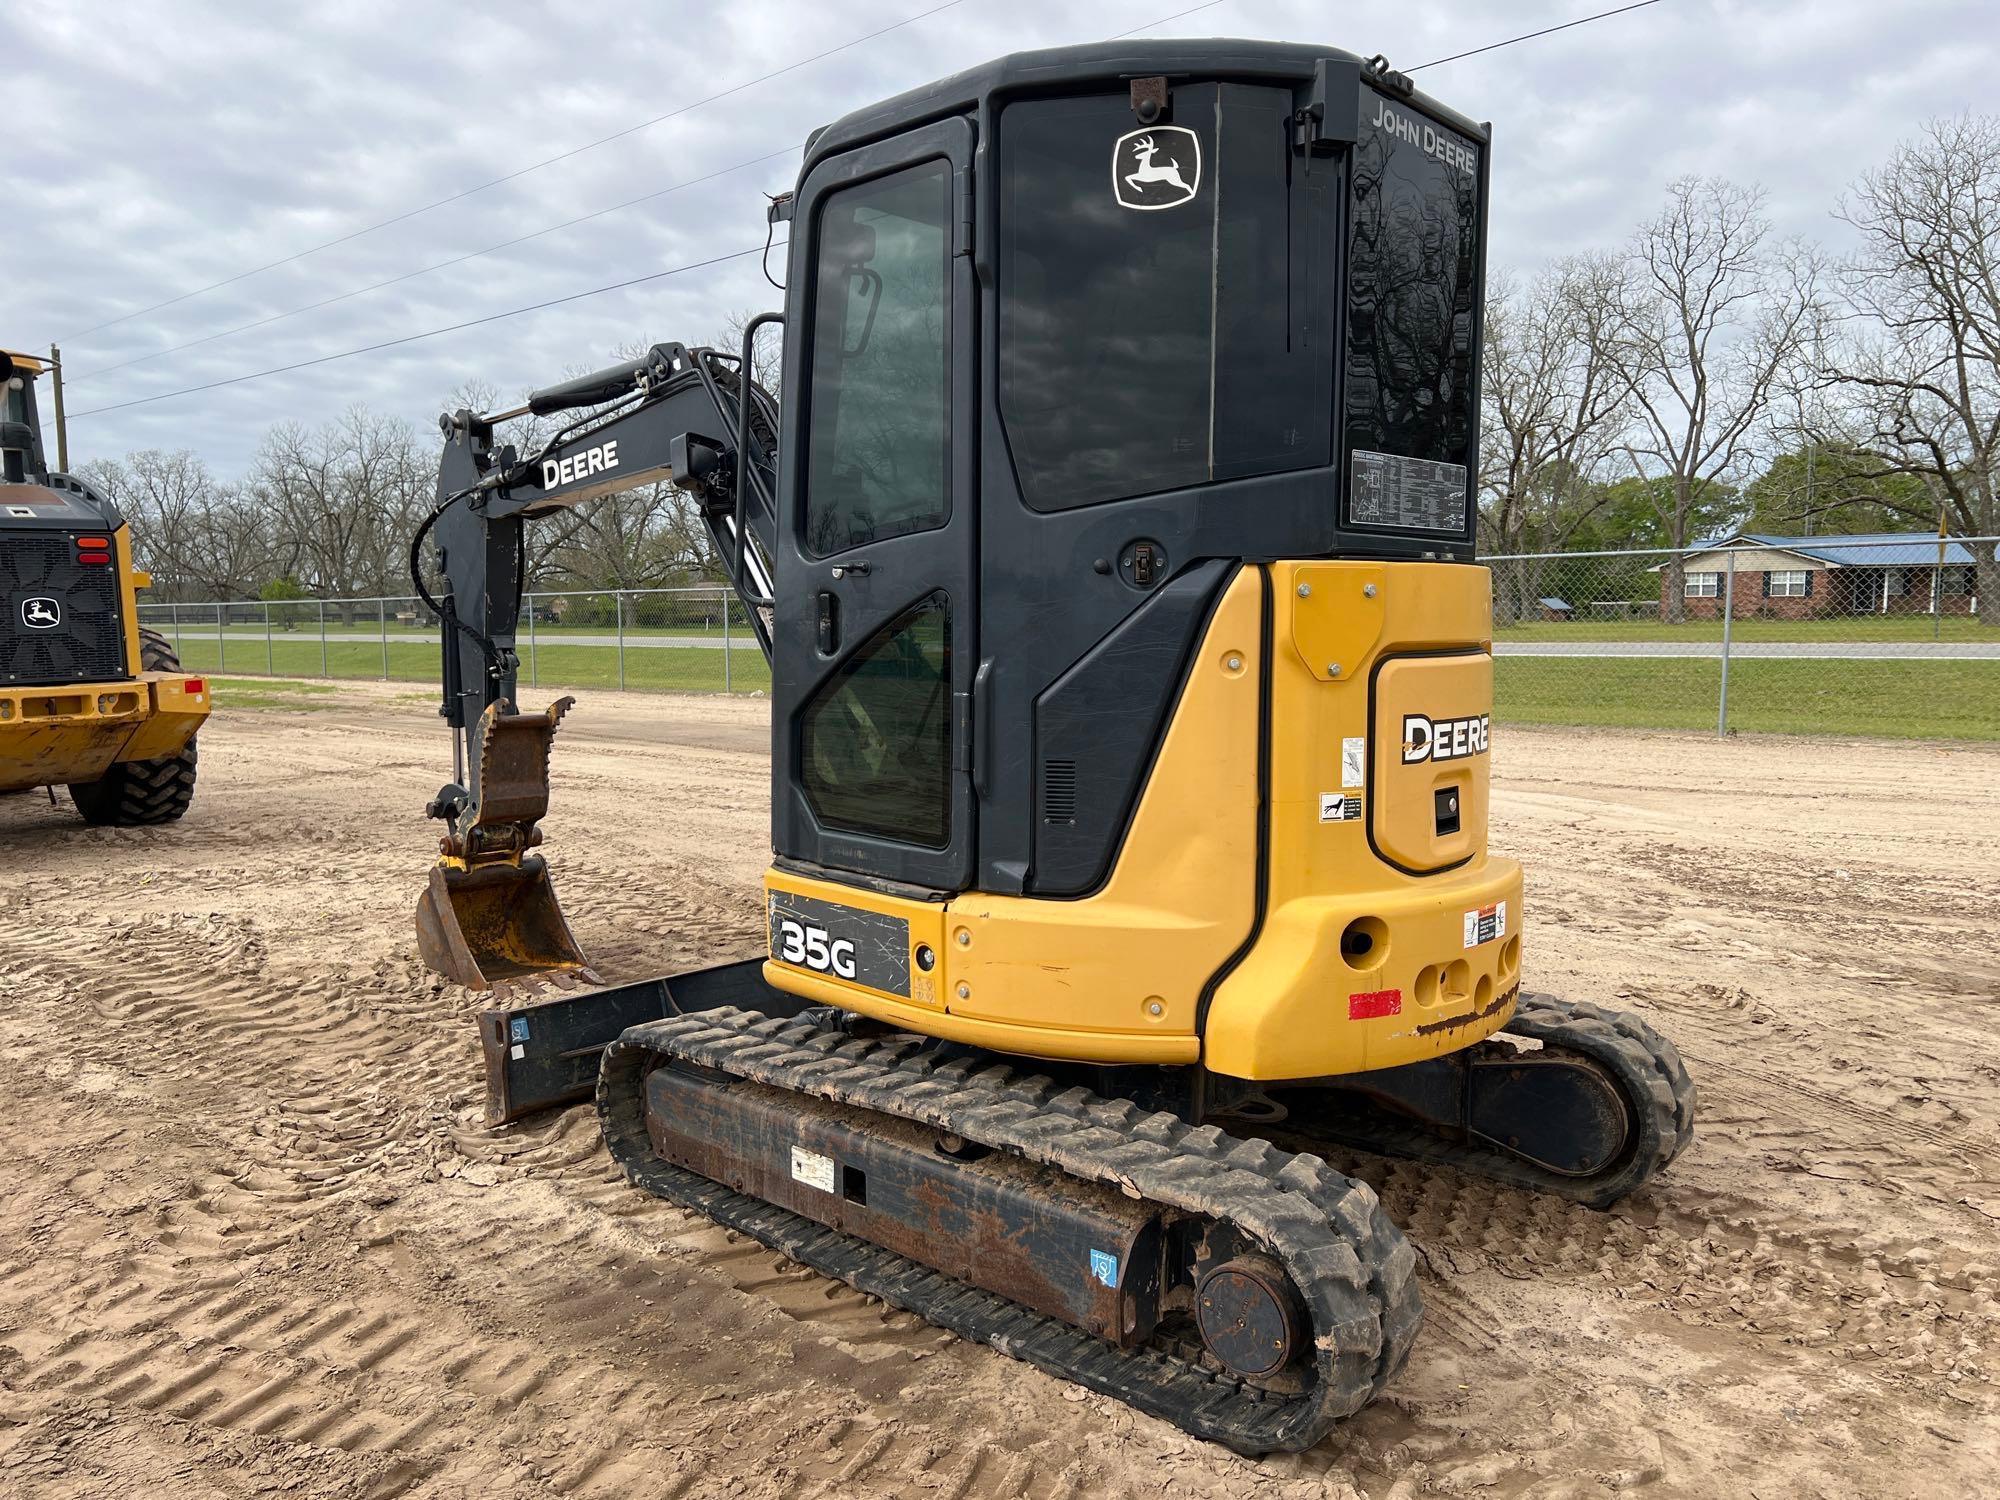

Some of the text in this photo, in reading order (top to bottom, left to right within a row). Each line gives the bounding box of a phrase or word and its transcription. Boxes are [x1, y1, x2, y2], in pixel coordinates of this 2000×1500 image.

[1372, 100, 1475, 176] JOHN DEERE
[542, 440, 620, 491] DEERE
[1403, 715, 1489, 763] DEERE
[780, 920, 856, 979] 35G
